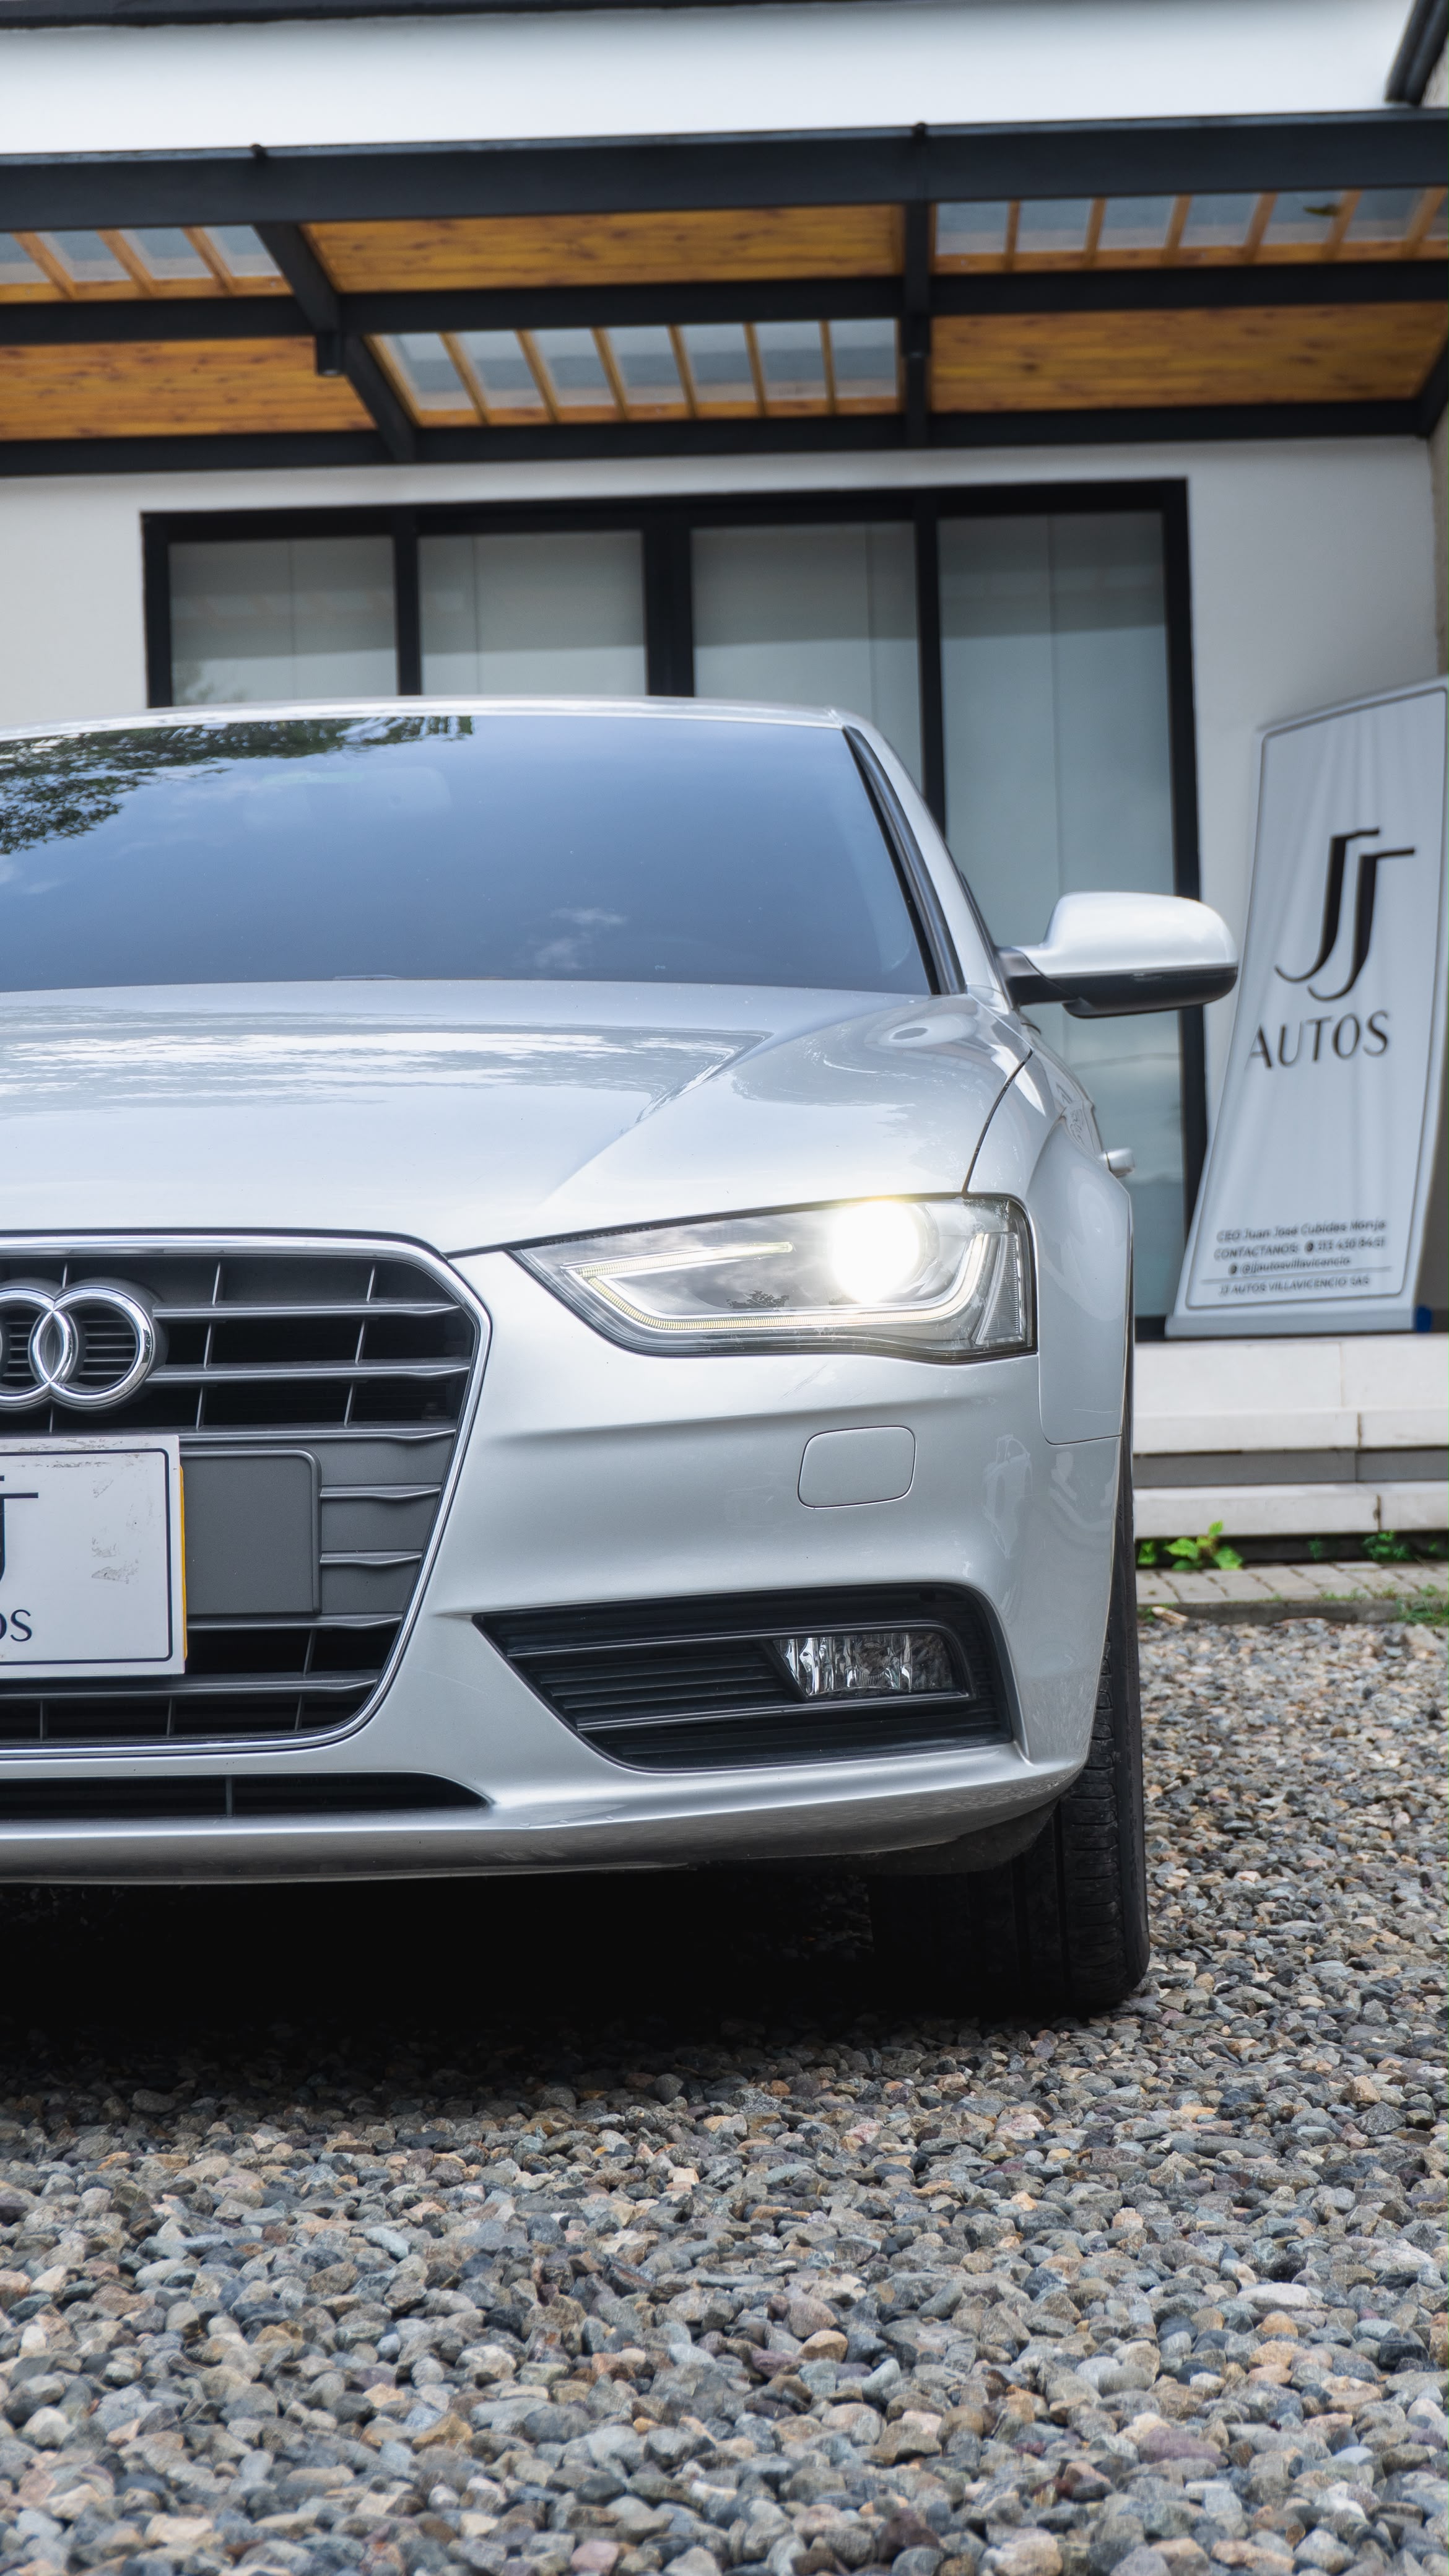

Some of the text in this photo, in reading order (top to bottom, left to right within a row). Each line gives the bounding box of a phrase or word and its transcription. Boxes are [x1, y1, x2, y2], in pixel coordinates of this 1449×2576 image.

[1245, 1010, 1389, 1069] AUTOS
[1217, 1230, 1240, 1242] CEO
[1244, 1227, 1270, 1240] Juan
[1302, 1222, 1347, 1235] Cubides
[1231, 1282, 1266, 1295] AUTOS
[1268, 1277, 1347, 1292] VILLAVICENCIO
